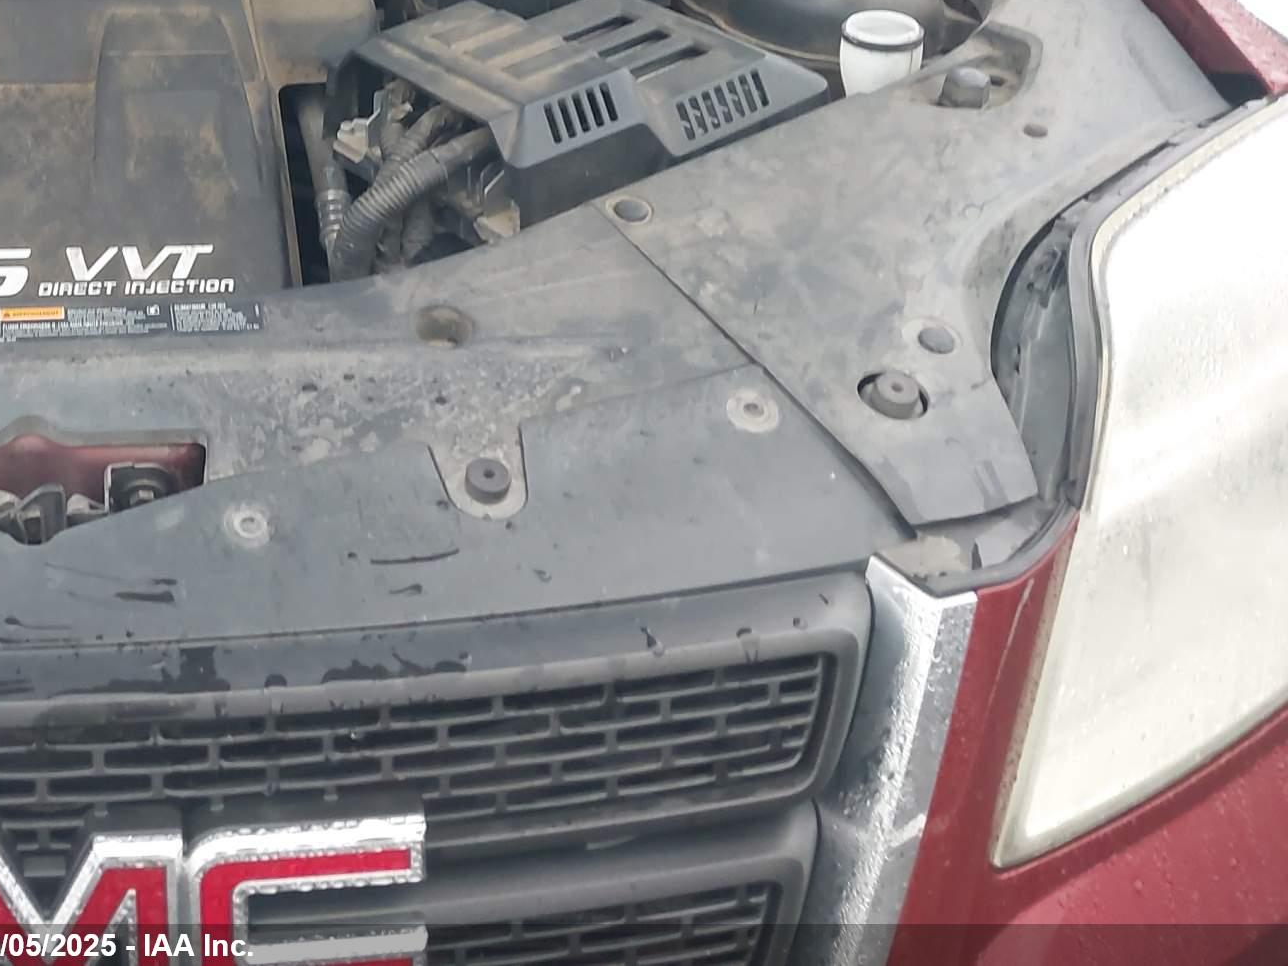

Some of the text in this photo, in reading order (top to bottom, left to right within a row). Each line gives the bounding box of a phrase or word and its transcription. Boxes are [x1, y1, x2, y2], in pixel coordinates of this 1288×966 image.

[65, 244, 213, 281] VVT
[37, 277, 234, 297] DIRECT INJECTION
